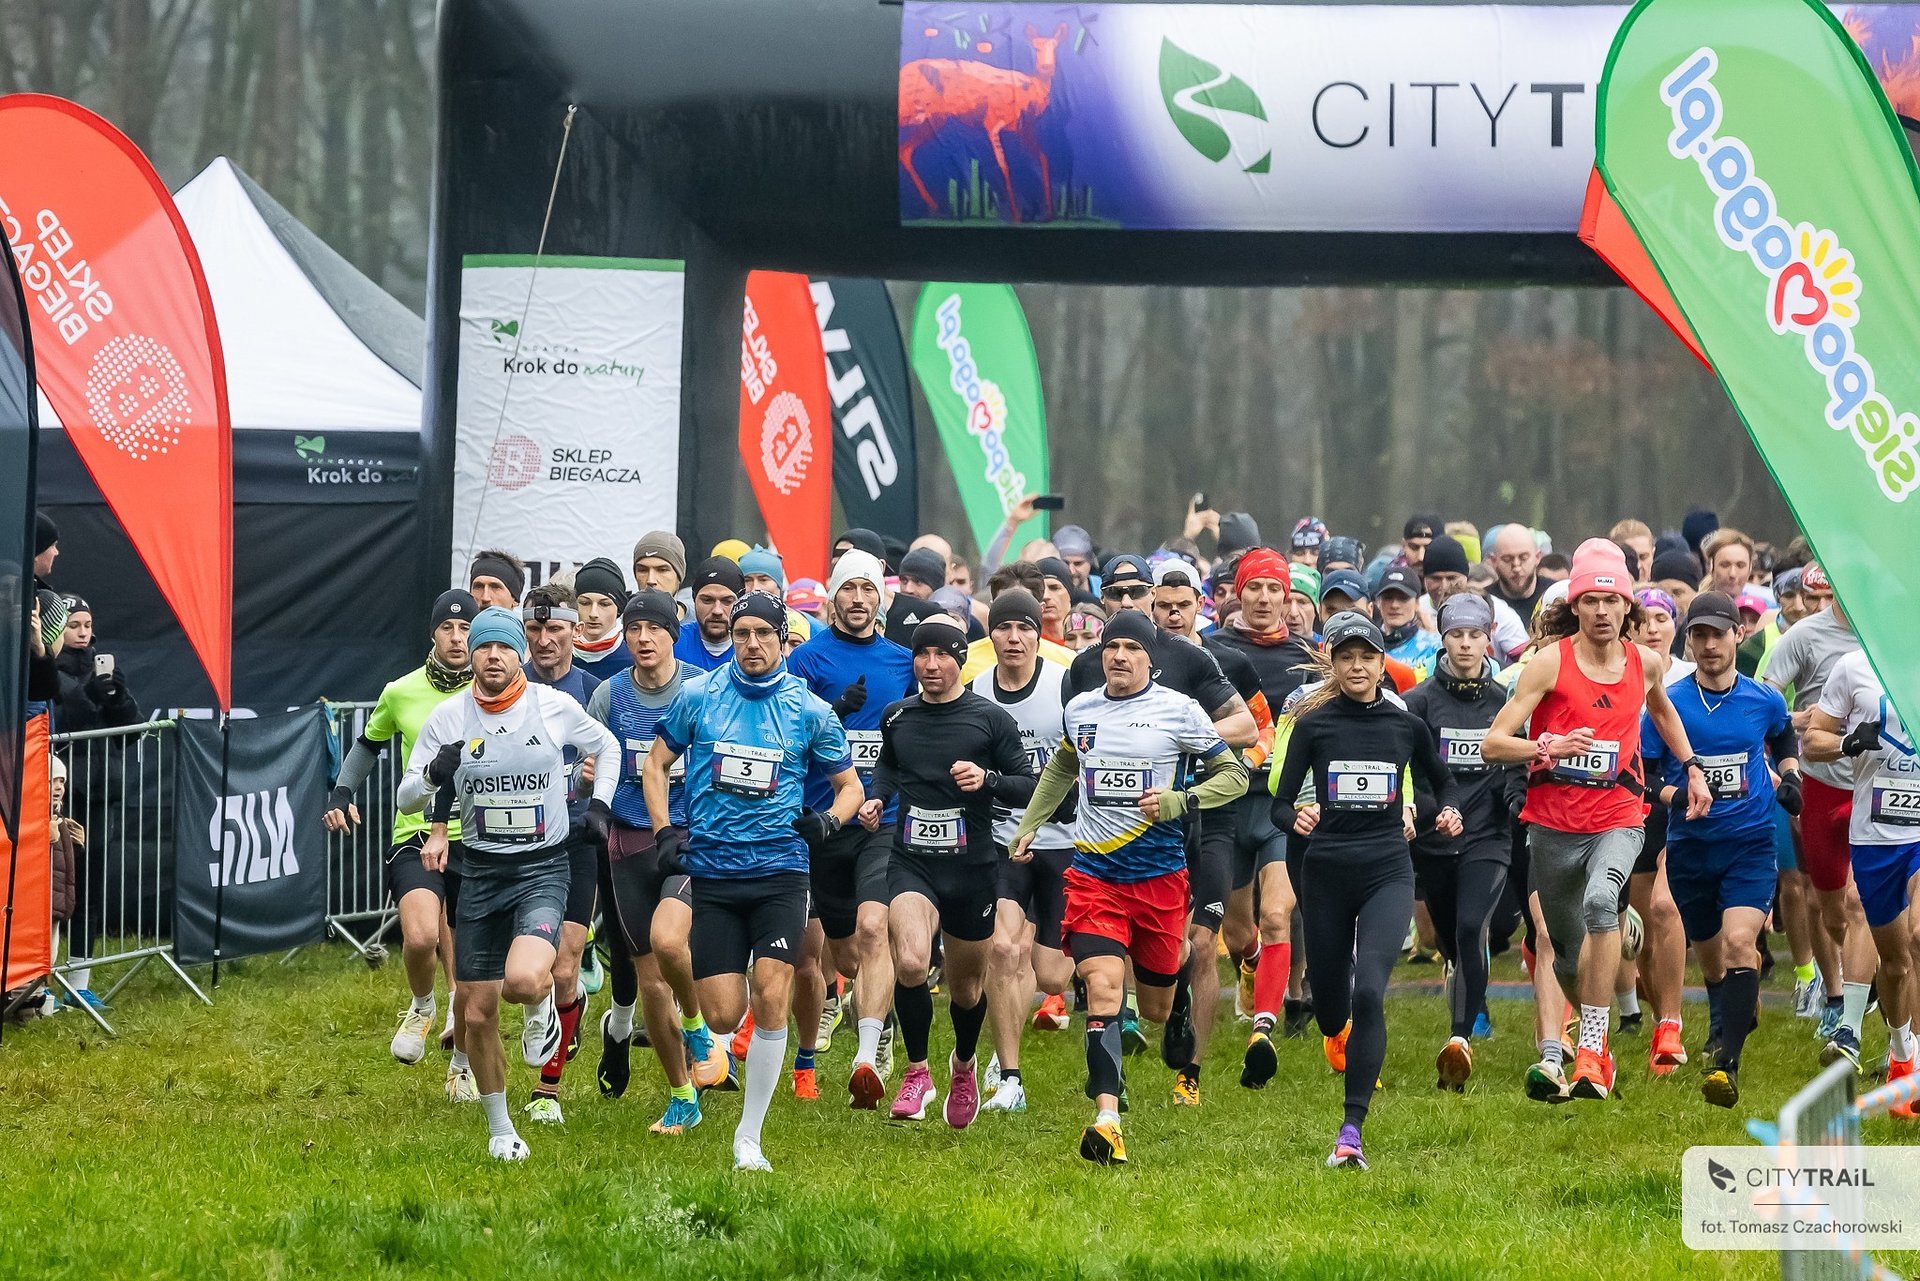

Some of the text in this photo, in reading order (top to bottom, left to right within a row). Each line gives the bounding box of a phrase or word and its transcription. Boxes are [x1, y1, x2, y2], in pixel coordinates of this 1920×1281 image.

[1312, 82, 1600, 148] CITYT
[504, 357, 645, 386] Krok do natury
[551, 448, 613, 464] SKLEP
[307, 467, 353, 484] Krok
[357, 467, 382, 483] do
[550, 466, 642, 484] BIEGACZA
[740, 761, 753, 777] 3
[464, 772, 550, 795] GOSIEWSKI
[1099, 773, 1137, 788] 456
[1356, 776, 1369, 791] 9
[504, 811, 513, 826] 1
[208, 786, 300, 887] SILVA
[918, 823, 948, 838] 291
